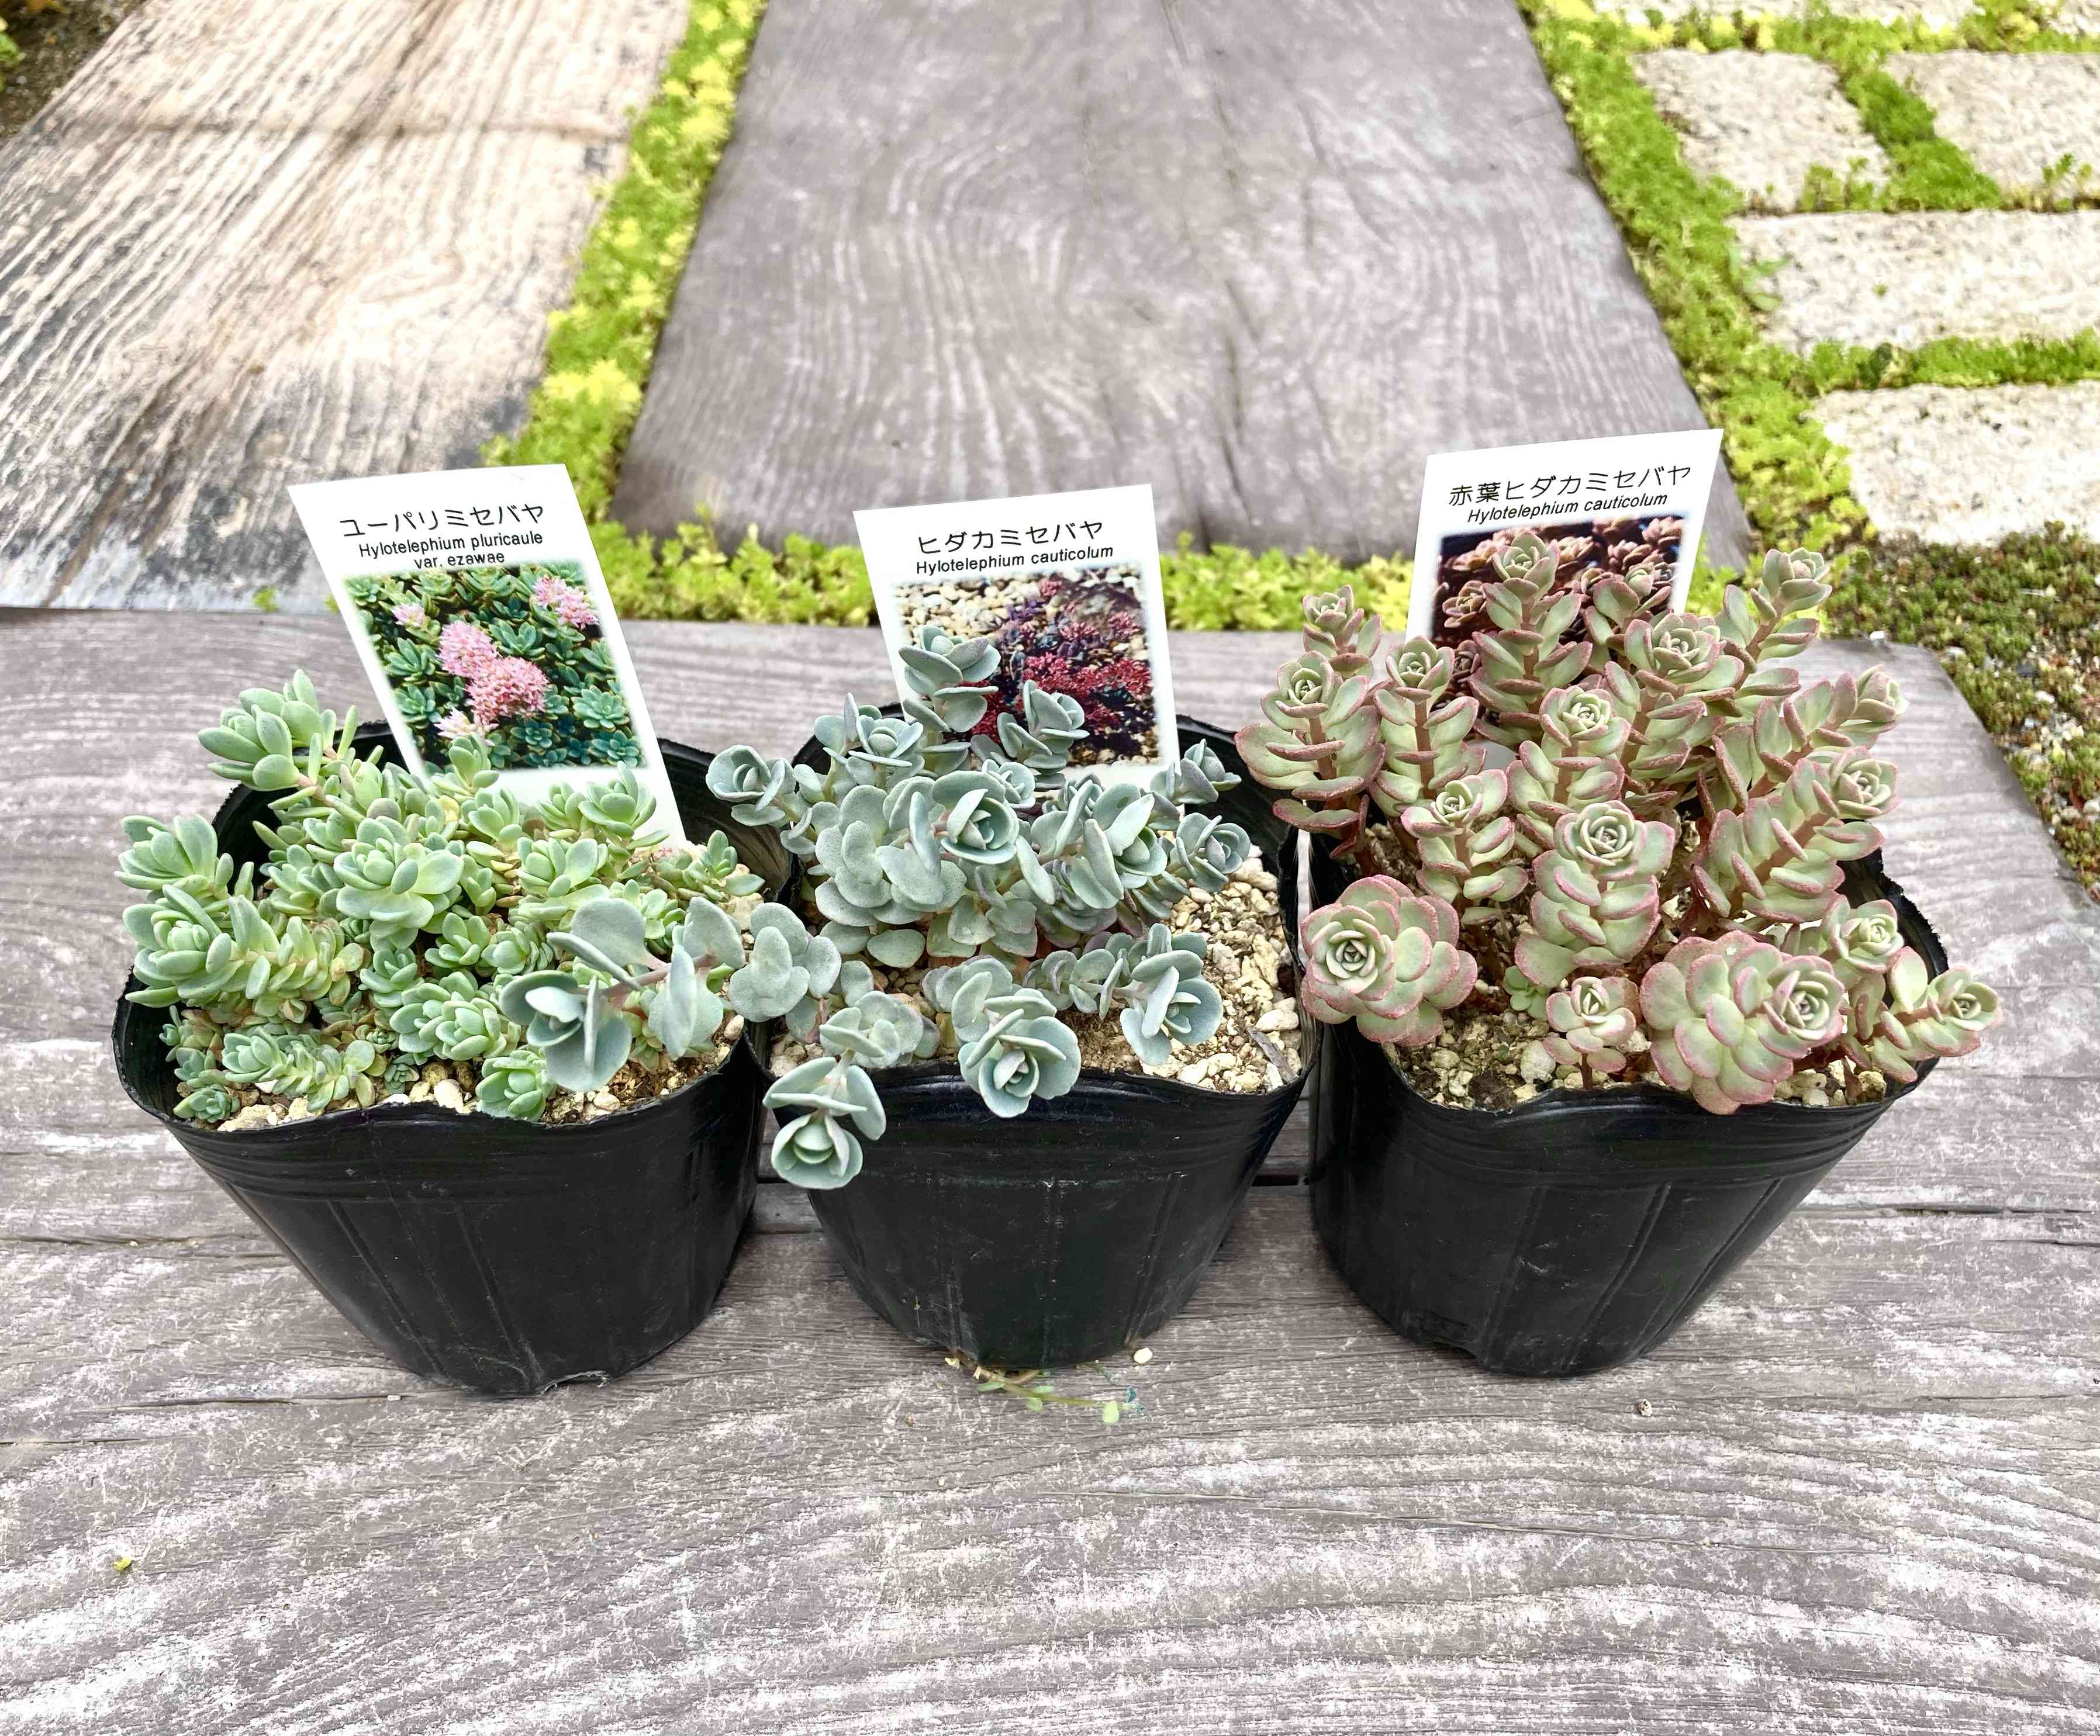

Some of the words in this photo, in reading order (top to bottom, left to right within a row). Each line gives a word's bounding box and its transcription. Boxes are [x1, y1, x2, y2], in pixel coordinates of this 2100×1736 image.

[1449, 465, 1691, 506] 赤葉ヒダカミセバヤ
[340, 504, 543, 537] ユーパリミセバヤ
[1467, 500, 1579, 525] Hylotelephium
[1584, 493, 1668, 511] cauticolum
[358, 537, 465, 559] Hylotelephium
[471, 530, 543, 551] pluricaule
[918, 521, 1103, 554] ヒダカミセバヤ
[414, 557, 443, 569] var.
[447, 552, 505, 567] ezawae
[917, 554, 1024, 576] Hylotelephium
[1031, 546, 1113, 565] cauticolum
